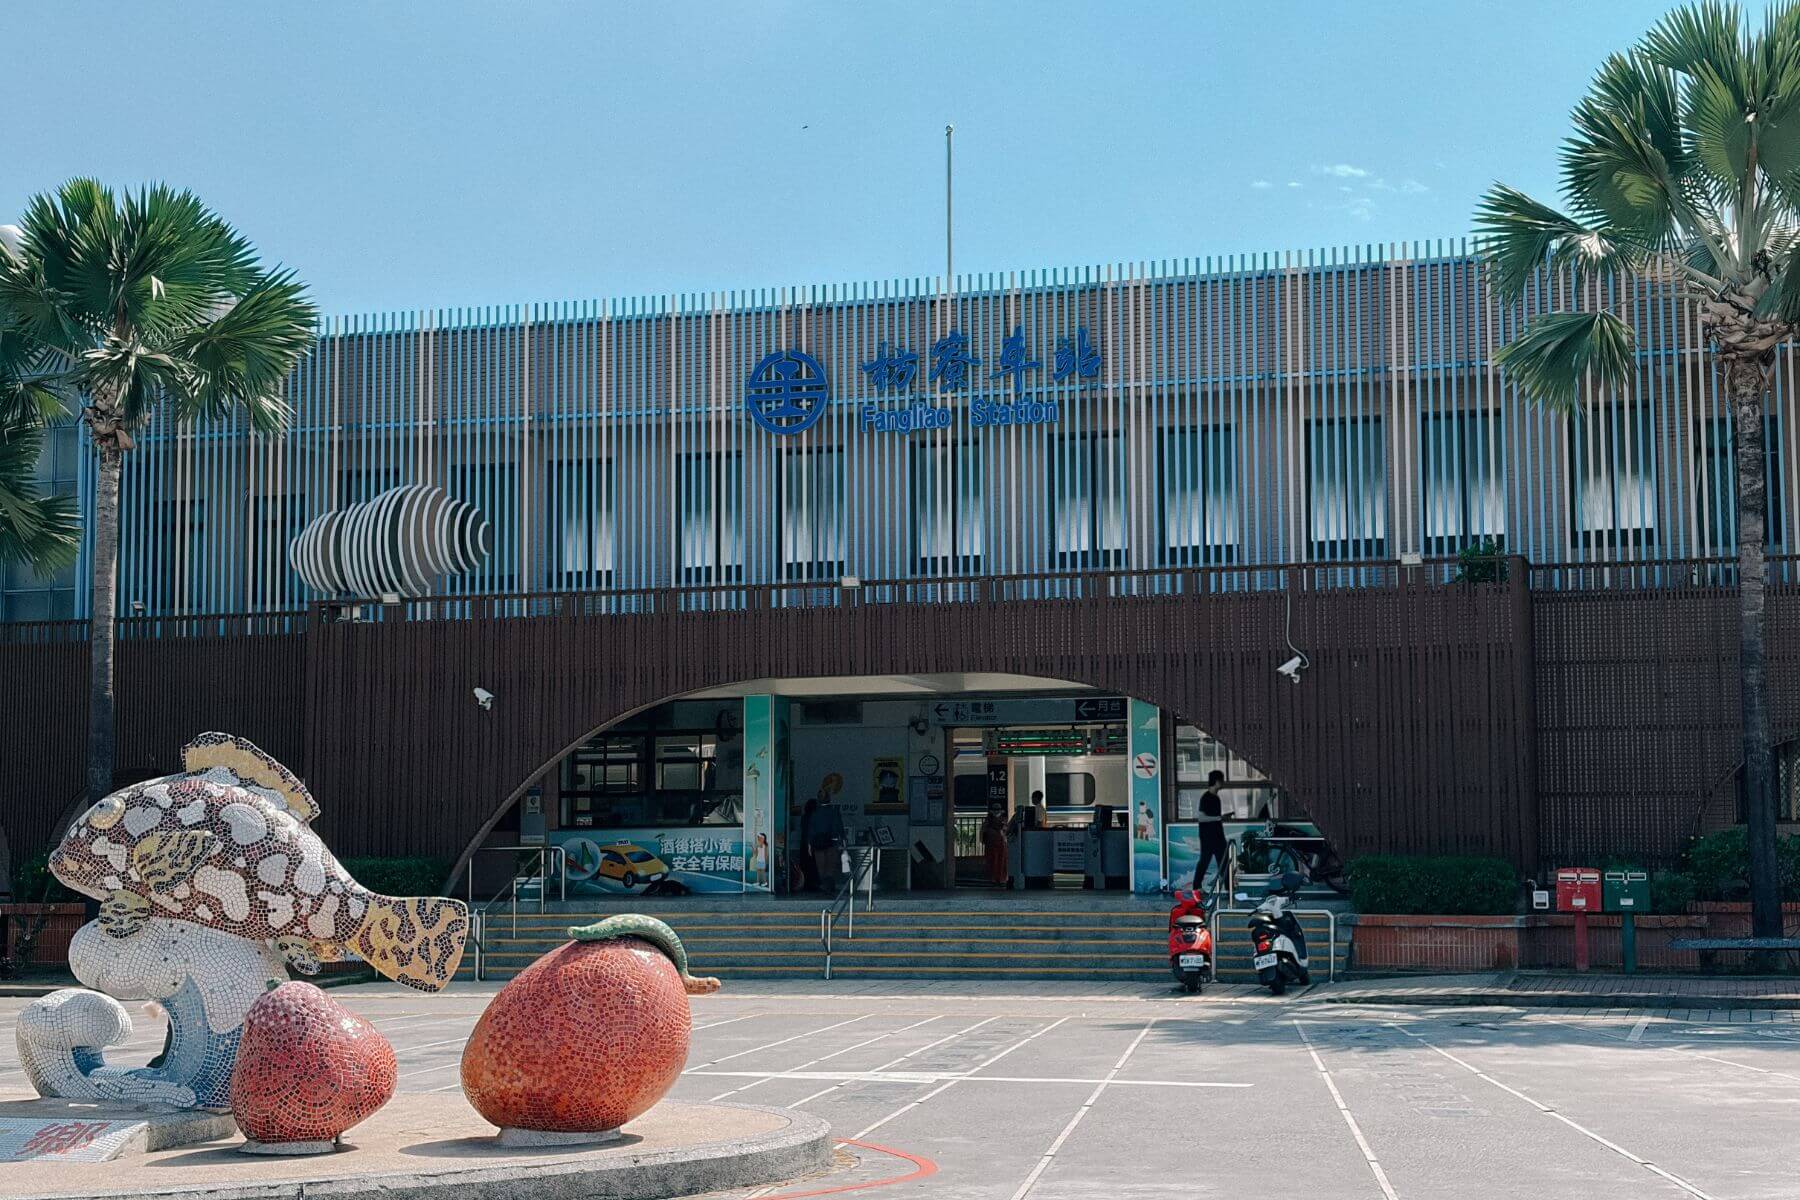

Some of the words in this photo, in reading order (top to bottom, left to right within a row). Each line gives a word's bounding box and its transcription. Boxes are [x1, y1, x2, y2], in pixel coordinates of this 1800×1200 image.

[862, 325, 1102, 393] 枋寮車站
[861, 404, 952, 434] Fangliao
[970, 398, 1059, 427] Station
[971, 702, 994, 713] 電梯
[1097, 700, 1121, 712] 月台
[989, 786, 1006, 795] 月台
[660, 838, 732, 854] 酒後搭小黃
[672, 855, 744, 872] 安全有保障
